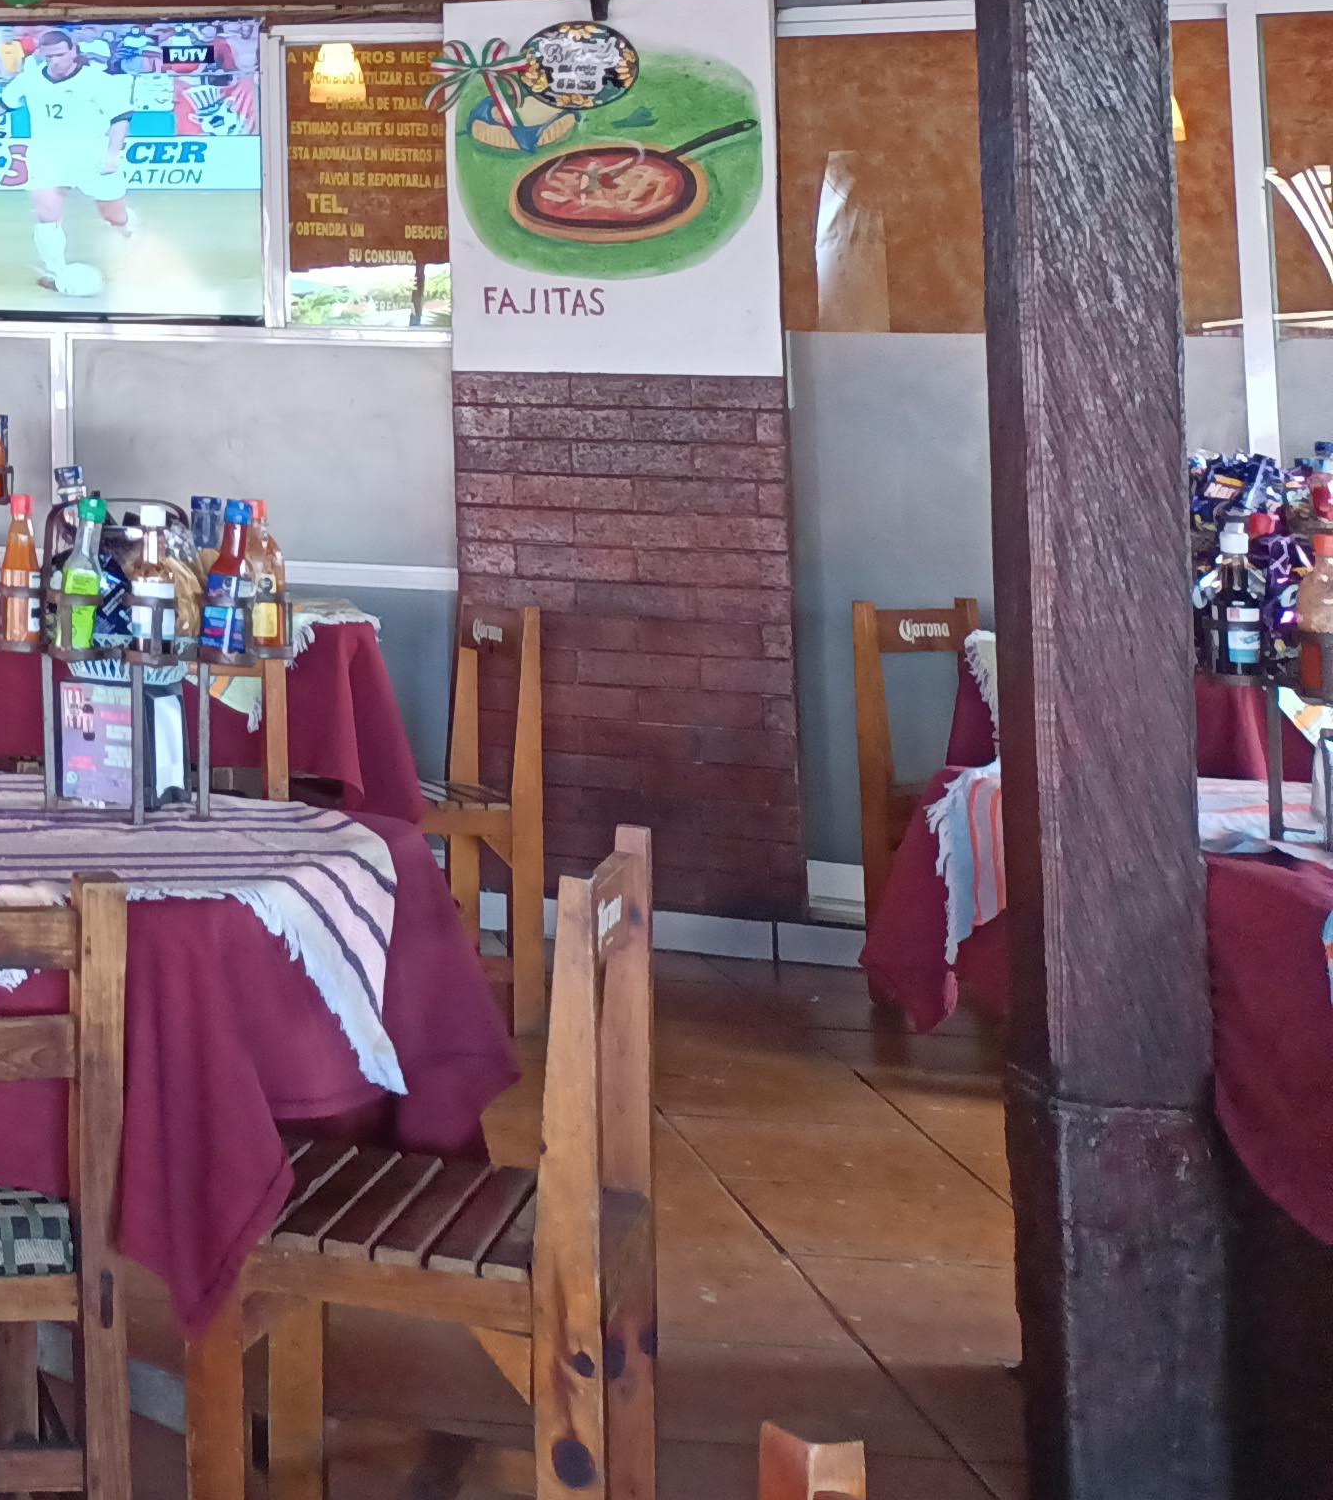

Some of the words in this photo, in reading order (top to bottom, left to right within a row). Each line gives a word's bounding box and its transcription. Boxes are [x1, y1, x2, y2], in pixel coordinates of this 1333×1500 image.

[169, 48, 208, 62] FUTV
[405, 72, 417, 86] EL
[45, 103, 63, 120] 12
[290, 121, 339, 135] ESTIMADO
[341, 122, 381, 136] CLIENTE
[385, 122, 395, 136] SI
[396, 123, 429, 137] USTED
[125, 141, 208, 165] CER
[312, 147, 363, 161] ANOMALIA
[364, 148, 378, 161] EN
[380, 148, 432, 162] NUESTROS
[128, 169, 203, 185] ATION
[319, 171, 349, 186] FAVOR
[352, 172, 366, 187] DE
[368, 173, 431, 188] REPORTARLA
[306, 193, 349, 215] TEL.
[296, 222, 347, 237] OBTENDRA
[350, 223, 365, 238] UN
[348, 248, 362, 262] SU
[483, 286, 606, 317] FAJITAS
[899, 618, 950, 644] Corona
